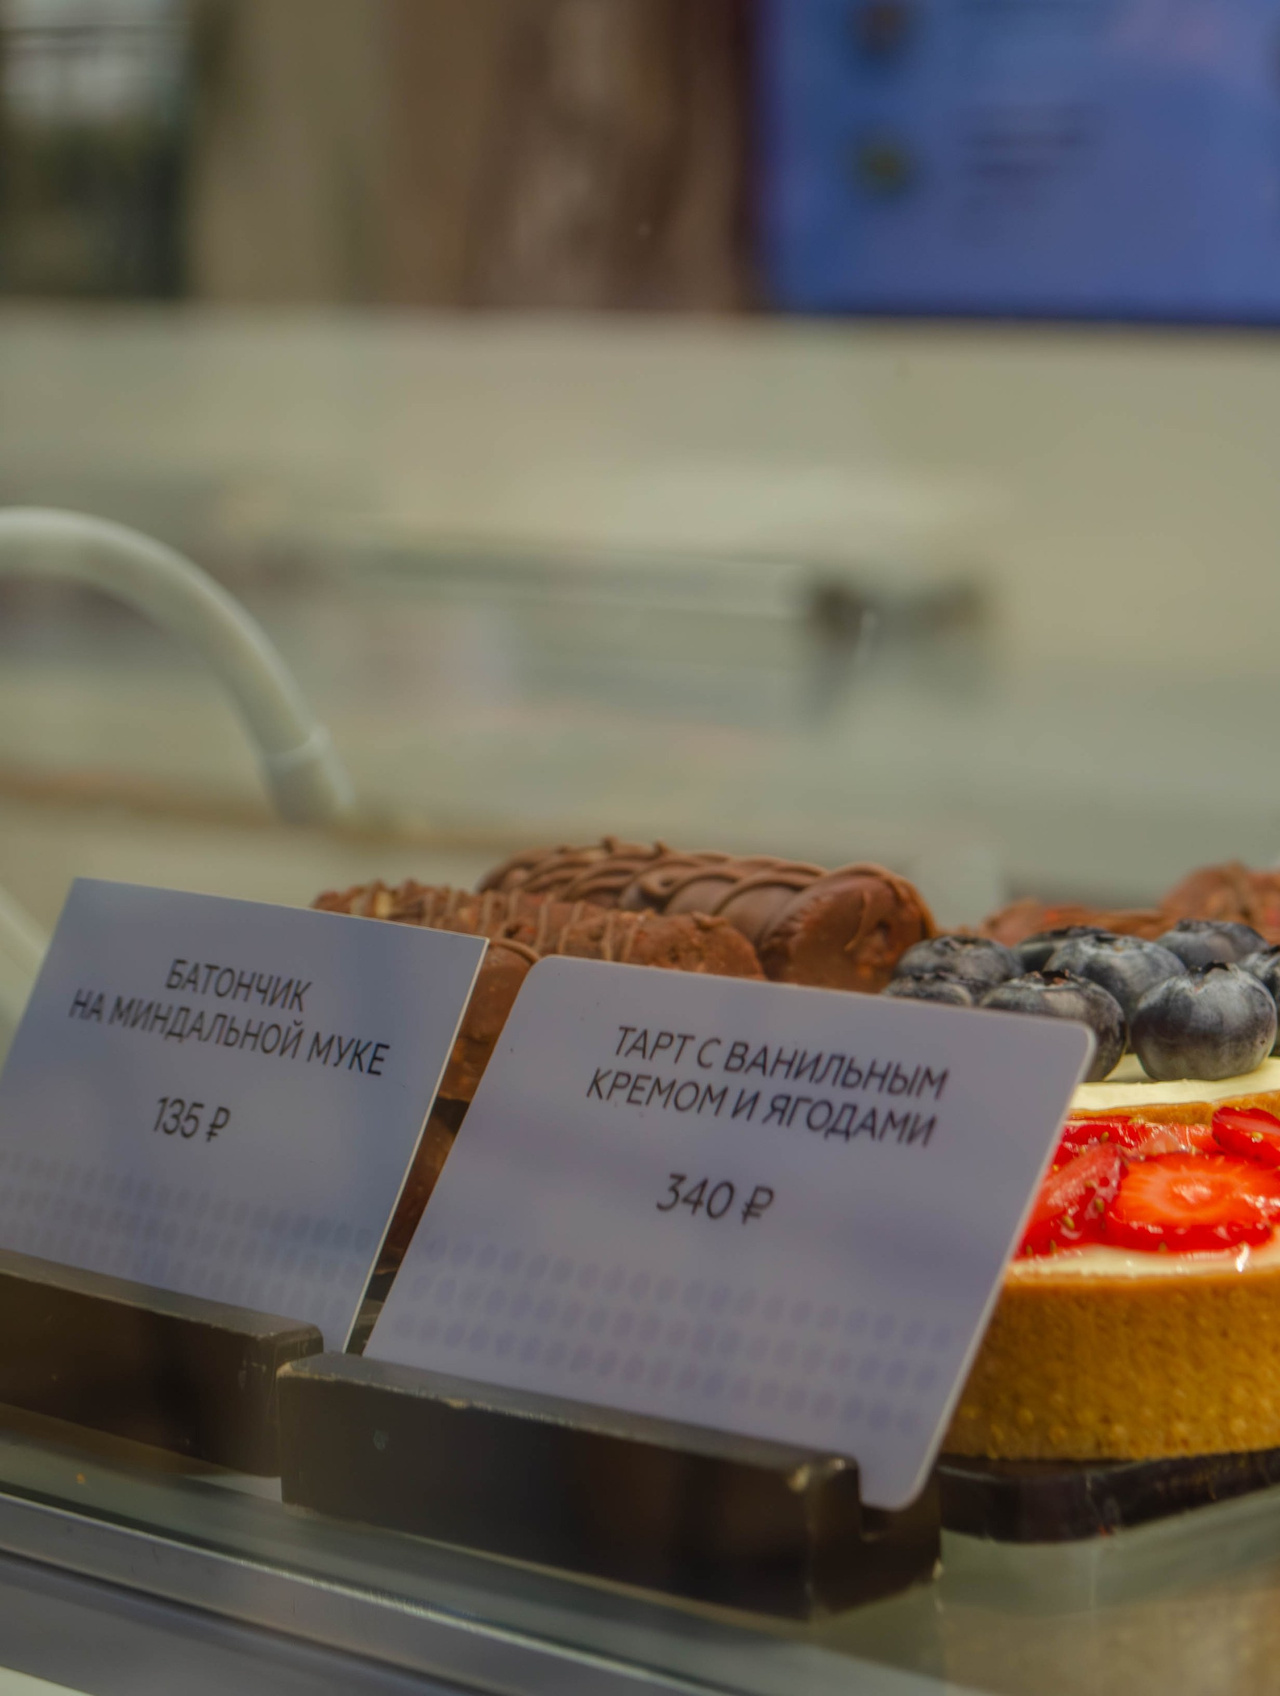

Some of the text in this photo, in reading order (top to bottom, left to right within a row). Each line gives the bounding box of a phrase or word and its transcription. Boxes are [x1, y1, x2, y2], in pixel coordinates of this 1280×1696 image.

[165, 959, 312, 1013] БАТОНЧИК
[68, 990, 390, 1076] НА МИНДАЛЬНОЙ МУКЕ
[614, 1026, 949, 1101] ТАРТ С ВАНИЛЬНЫМ
[154, 1096, 204, 1139] 135
[586, 1068, 938, 1147] КРЕМОМ И ЯГОДАМИ
[656, 1173, 734, 1220] 340
